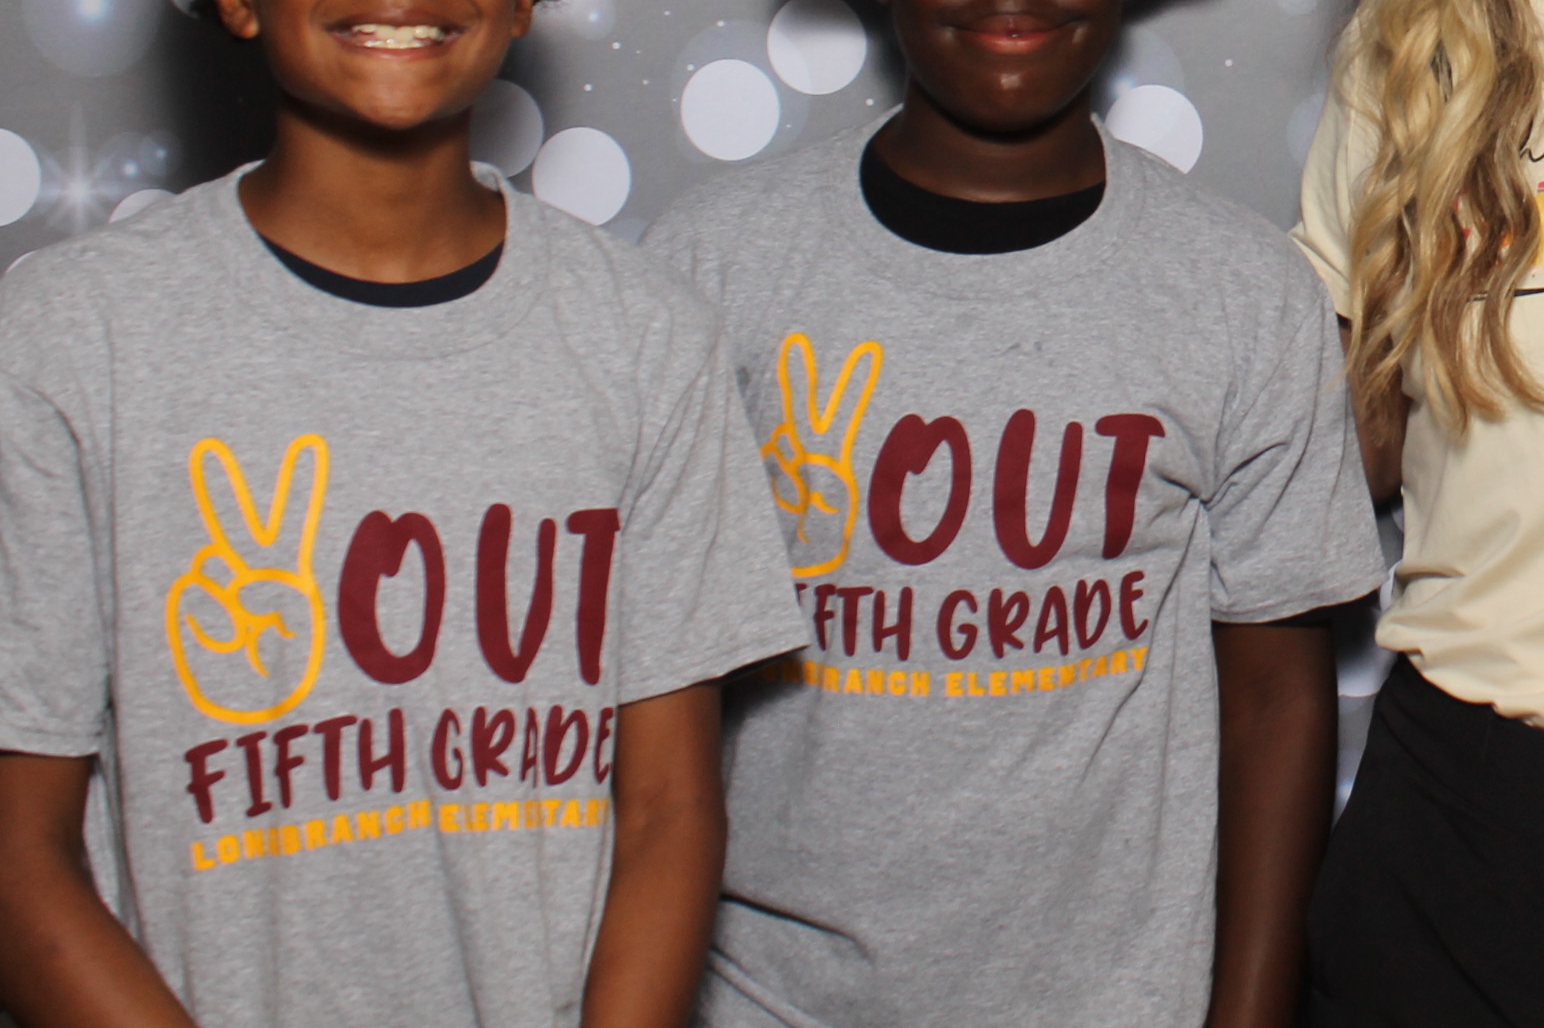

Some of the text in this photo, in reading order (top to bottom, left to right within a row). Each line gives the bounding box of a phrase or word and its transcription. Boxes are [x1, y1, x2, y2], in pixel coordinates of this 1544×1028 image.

[867, 408, 1166, 570] OUT
[338, 503, 621, 685] OUT
[794, 570, 1149, 662] FTH GRADE
[945, 646, 1149, 697] ELEMENTARY
[184, 704, 615, 824] FIFTH GRADE
